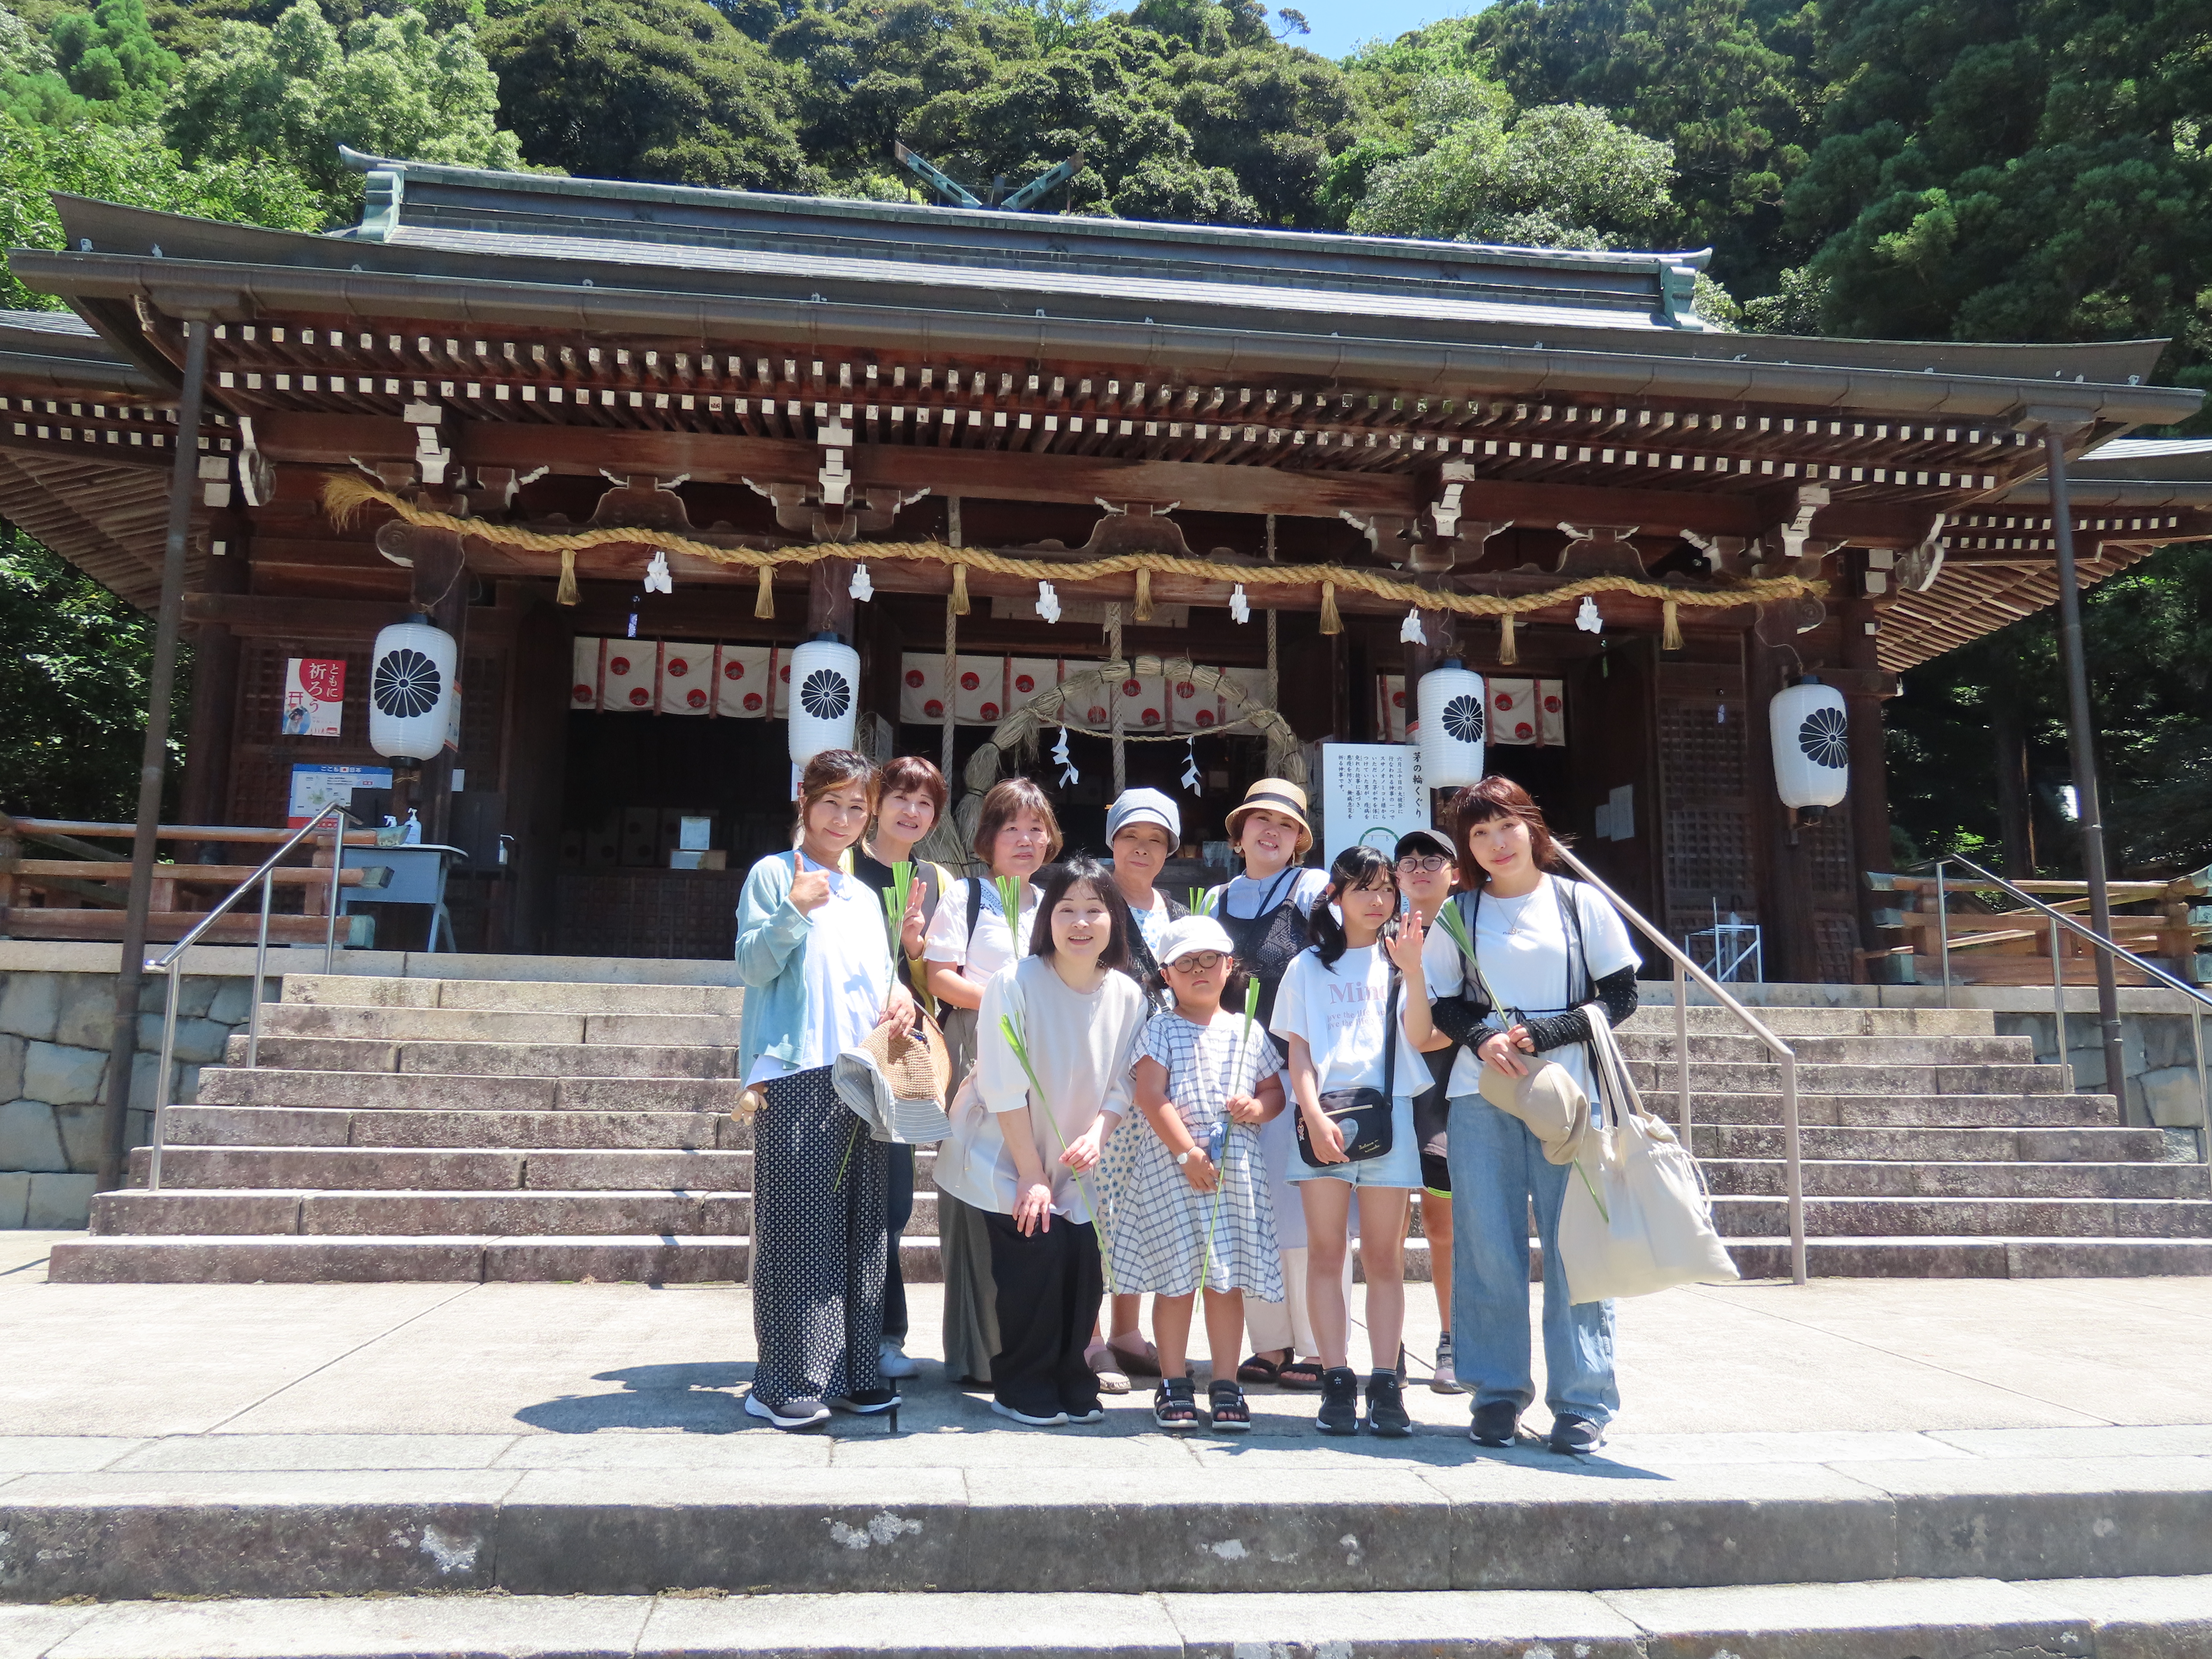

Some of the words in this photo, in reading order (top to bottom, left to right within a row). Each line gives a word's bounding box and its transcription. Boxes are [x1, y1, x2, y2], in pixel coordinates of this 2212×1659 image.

[308, 663, 327, 713] 祈ろう
[326, 663, 339, 698] ともに
[1412, 752, 1424, 819] 茅の輪くぐり
